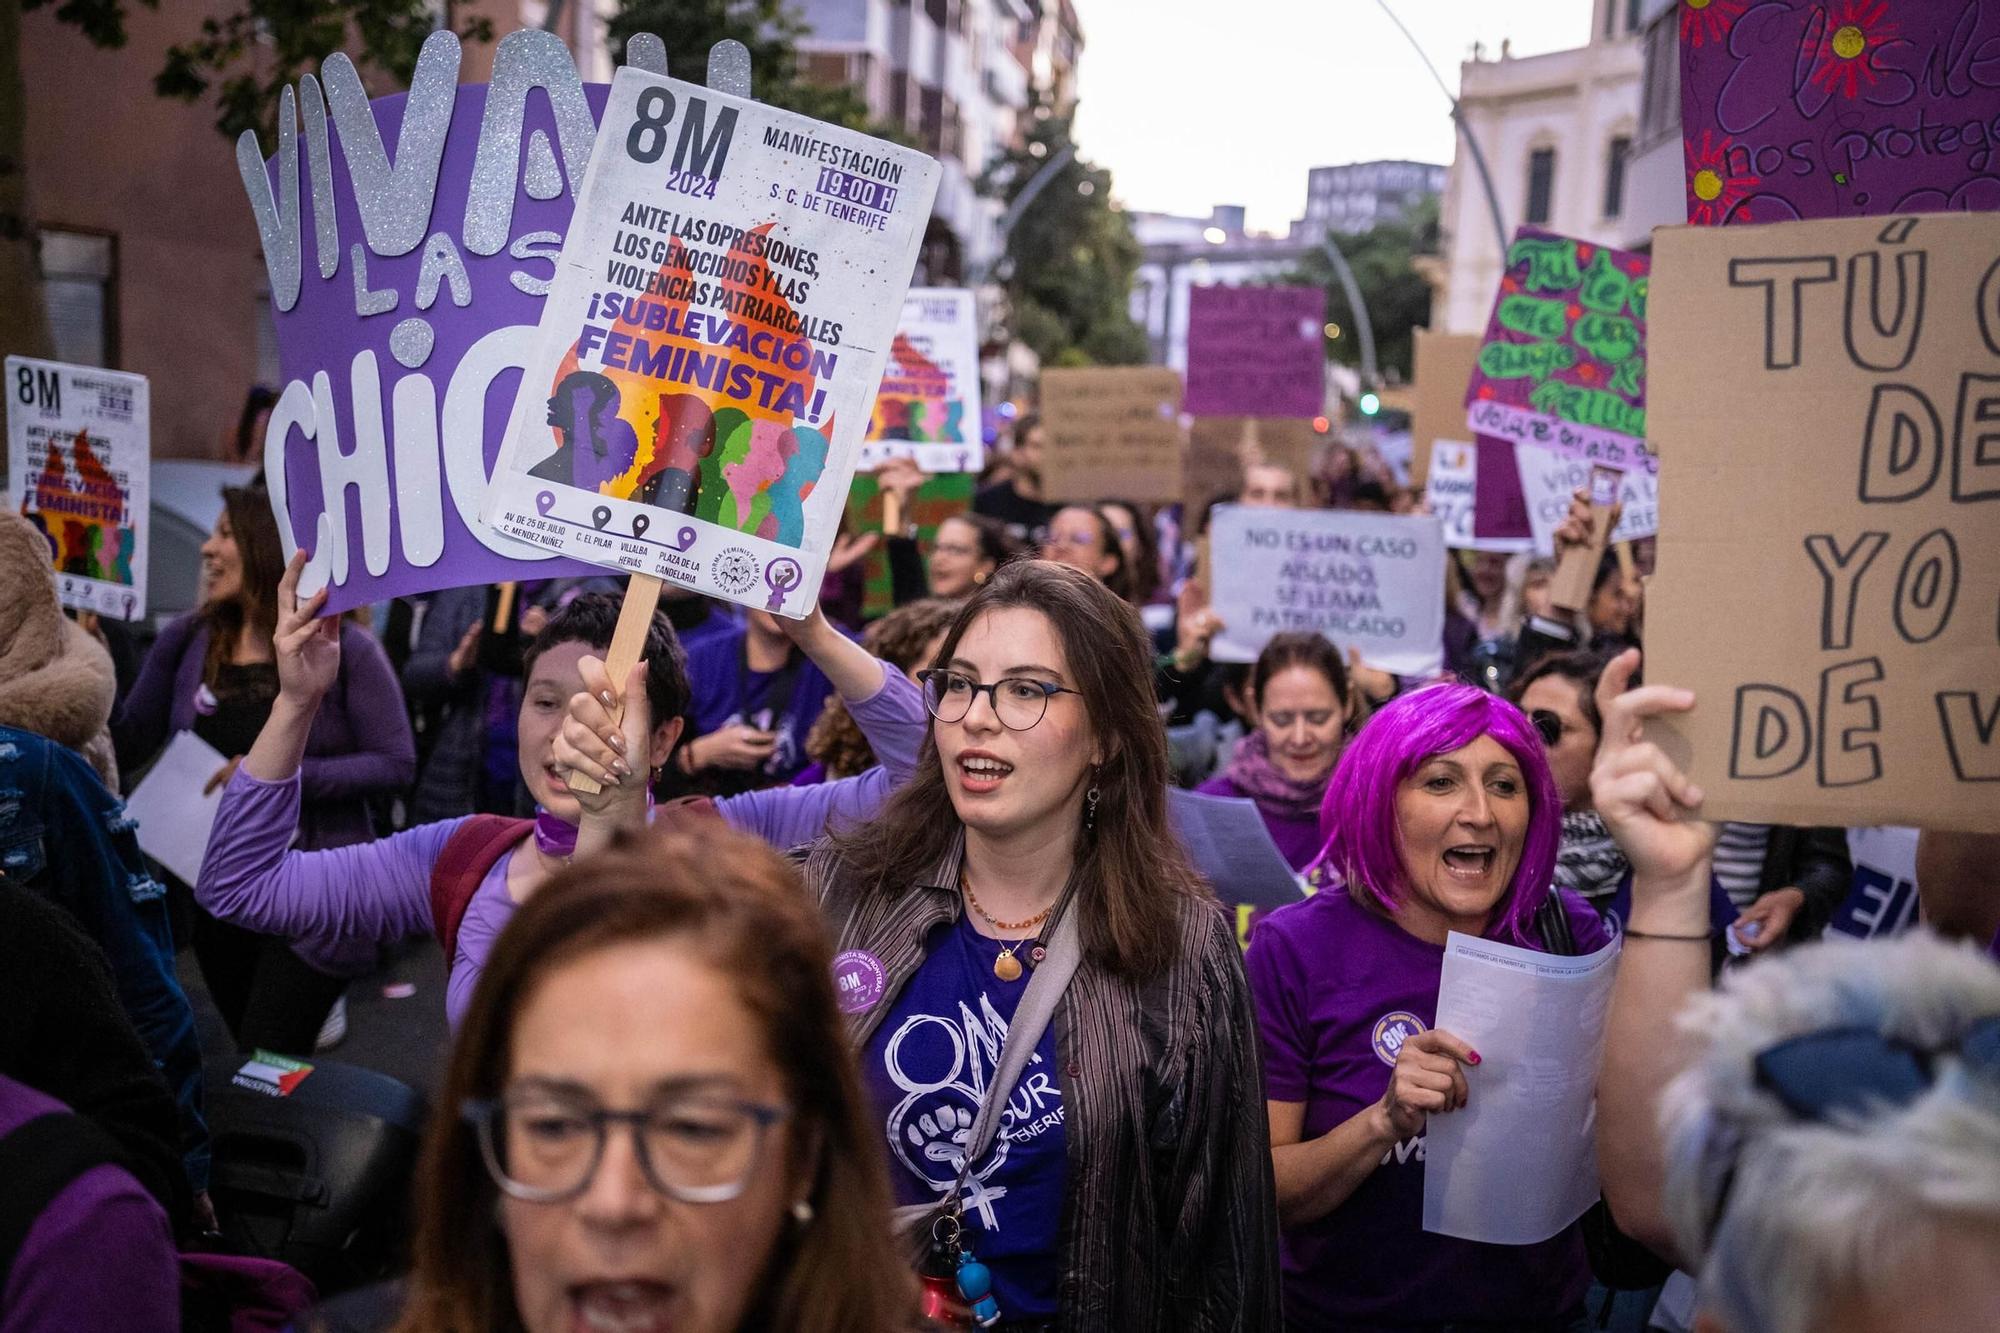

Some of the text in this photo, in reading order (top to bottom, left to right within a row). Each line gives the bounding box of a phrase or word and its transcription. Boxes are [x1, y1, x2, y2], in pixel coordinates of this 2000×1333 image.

[626, 86, 740, 182] 8M
[763, 126, 903, 185] MANIFESTACIÓN
[1725, 140, 1815, 177] nos
[665, 169, 719, 200] 2024
[820, 169, 897, 213] 19:00 H
[770, 183, 888, 231] S. C. DE TENERIFE
[620, 201, 820, 281] ANTE LAS OPRESIONES,
[351, 231, 563, 317] LAS
[612, 230, 810, 304] LOS GENOCIDIOS Y LAS
[606, 259, 711, 306] VIOLENCIAS
[710, 286, 843, 346] PATRIARCALES
[1728, 218, 1928, 373] TÚ
[587, 292, 838, 381] ¡SUBLEVACIÓN
[17, 366, 61, 413] 8M
[576, 324, 828, 424] FEMINISTA!
[516, 515, 525, 526] DE
[527, 518, 536, 529] 25
[536, 520, 547, 532] DE
[547, 523, 566, 536] JULIO
[583, 534, 593, 545] EL
[593, 537, 613, 549] PILAR
[1245, 528, 1418, 559] NO ES UN CASO
[620, 542, 648, 556] VILLALBA
[659, 551, 700, 572] PLAZA DE LA
[723, 546, 756, 562] FEMINISTA
[655, 564, 697, 585] CANDELARIA
[733, 576, 760, 595] TENERIFE
[1803, 528, 1961, 652] YO
[1252, 606, 1407, 639] PATRIARCADO
[1729, 656, 1885, 789] DE
[839, 971, 861, 992] 8M
[857, 952, 869, 961] SIN
[868, 957, 883, 993] FRONTERAS
